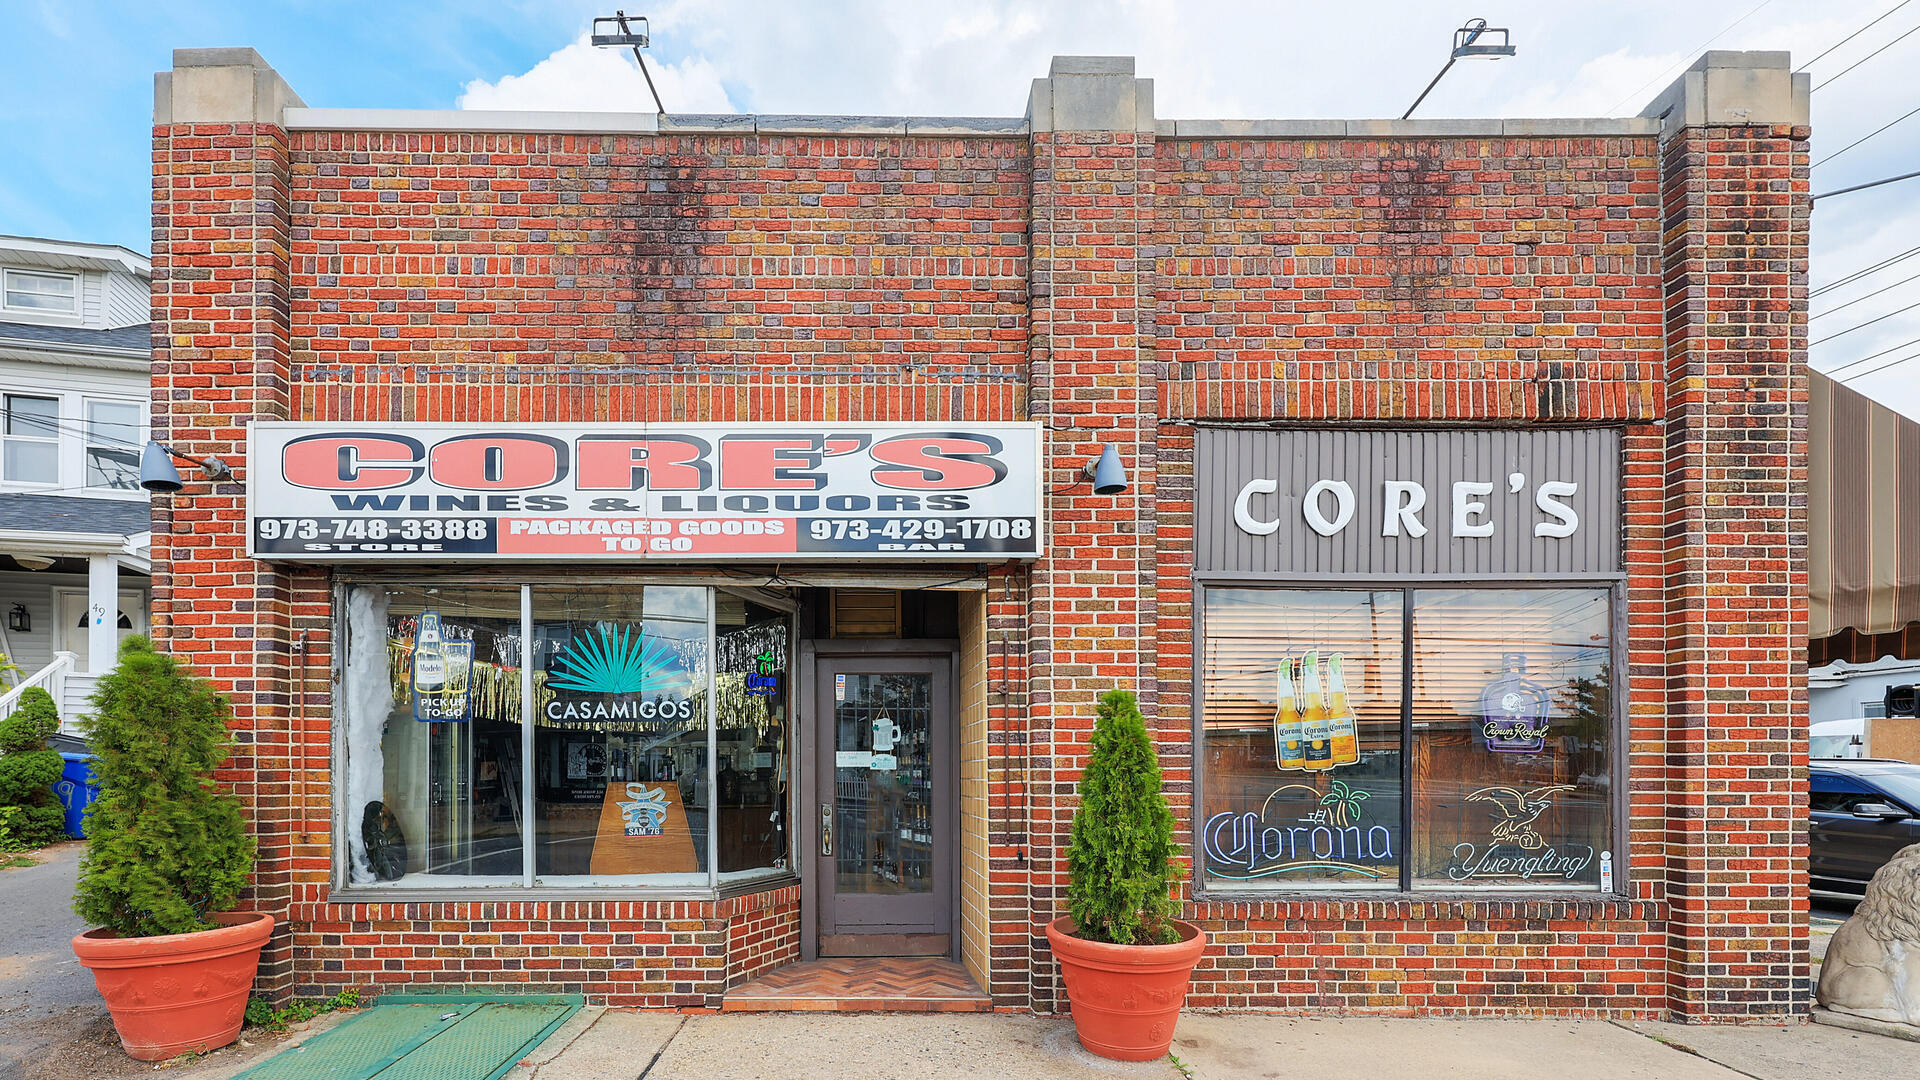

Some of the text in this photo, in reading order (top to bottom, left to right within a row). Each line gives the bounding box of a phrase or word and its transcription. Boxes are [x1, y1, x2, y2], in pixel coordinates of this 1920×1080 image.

[282, 432, 1008, 491] CORE'S
[331, 495, 971, 513] WINES & LIQUORS
[1233, 472, 1579, 539] CORE'S
[259, 519, 487, 540] 973-748-3388
[510, 521, 785, 535] PACKAGED GOODS
[810, 519, 1032, 540] 973-429-1708
[601, 537, 693, 551] TO GO
[92, 602, 106, 617] 49
[421, 698, 465, 707] PICK UP
[547, 701, 691, 719] CASAMIGOS
[424, 708, 463, 717] TO-GO
[1304, 727, 1329, 736] Corona
[1330, 723, 1352, 732] Corona
[1483, 722, 1549, 741] Crown Royal
[628, 828, 646, 836] SAM
[1203, 812, 1392, 870] Corona
[1449, 843, 1594, 881] Yuengling
